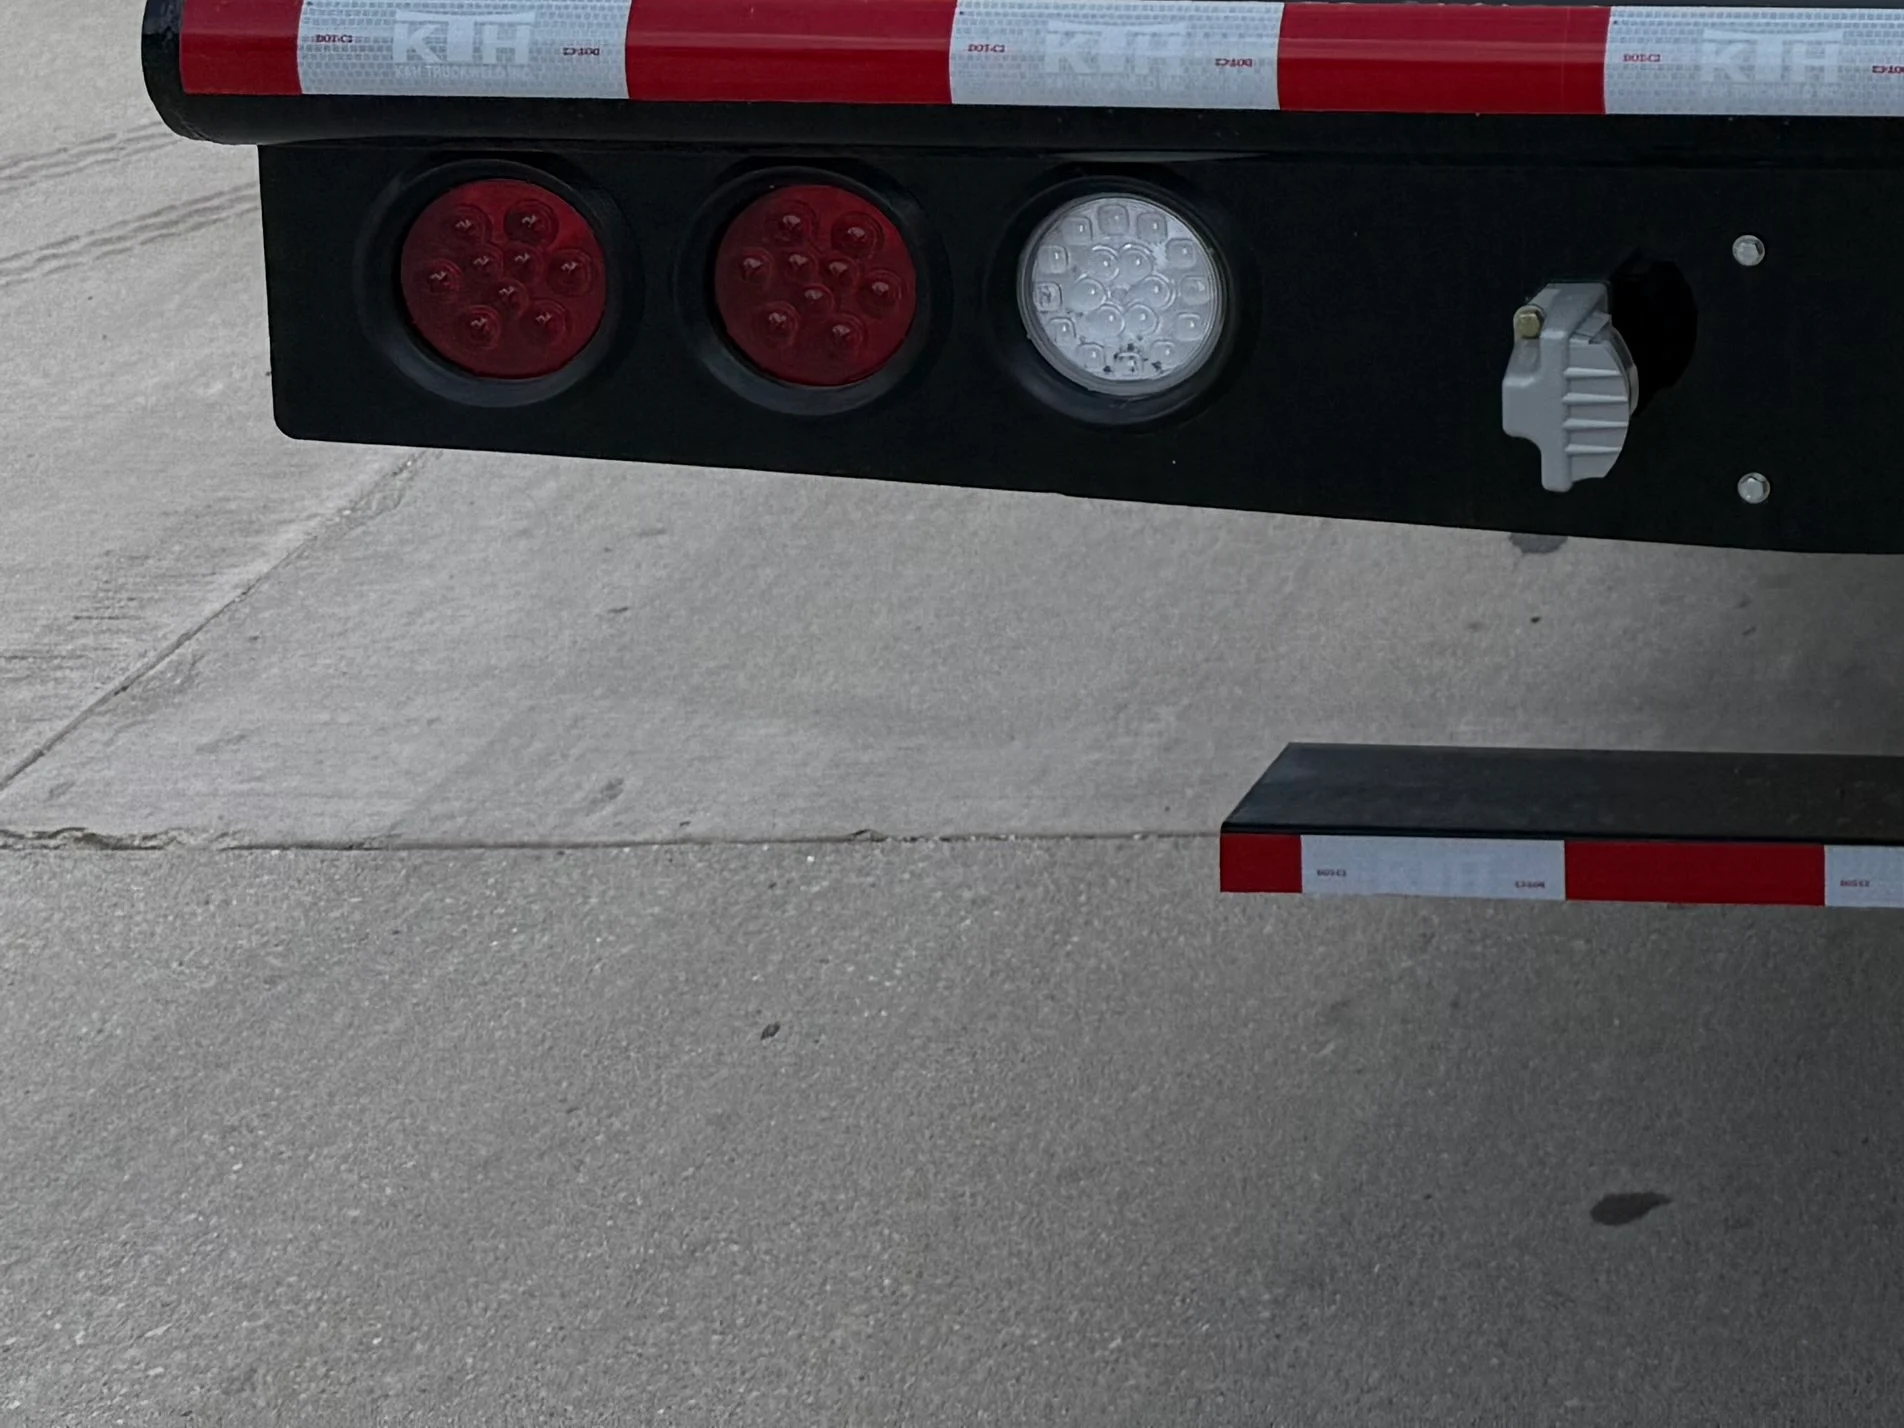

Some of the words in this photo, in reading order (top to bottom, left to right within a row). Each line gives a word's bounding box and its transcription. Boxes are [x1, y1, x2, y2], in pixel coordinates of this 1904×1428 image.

[392, 9, 537, 64] KTH
[1045, 19, 1188, 74] KTH
[1701, 27, 1845, 84] KTH
